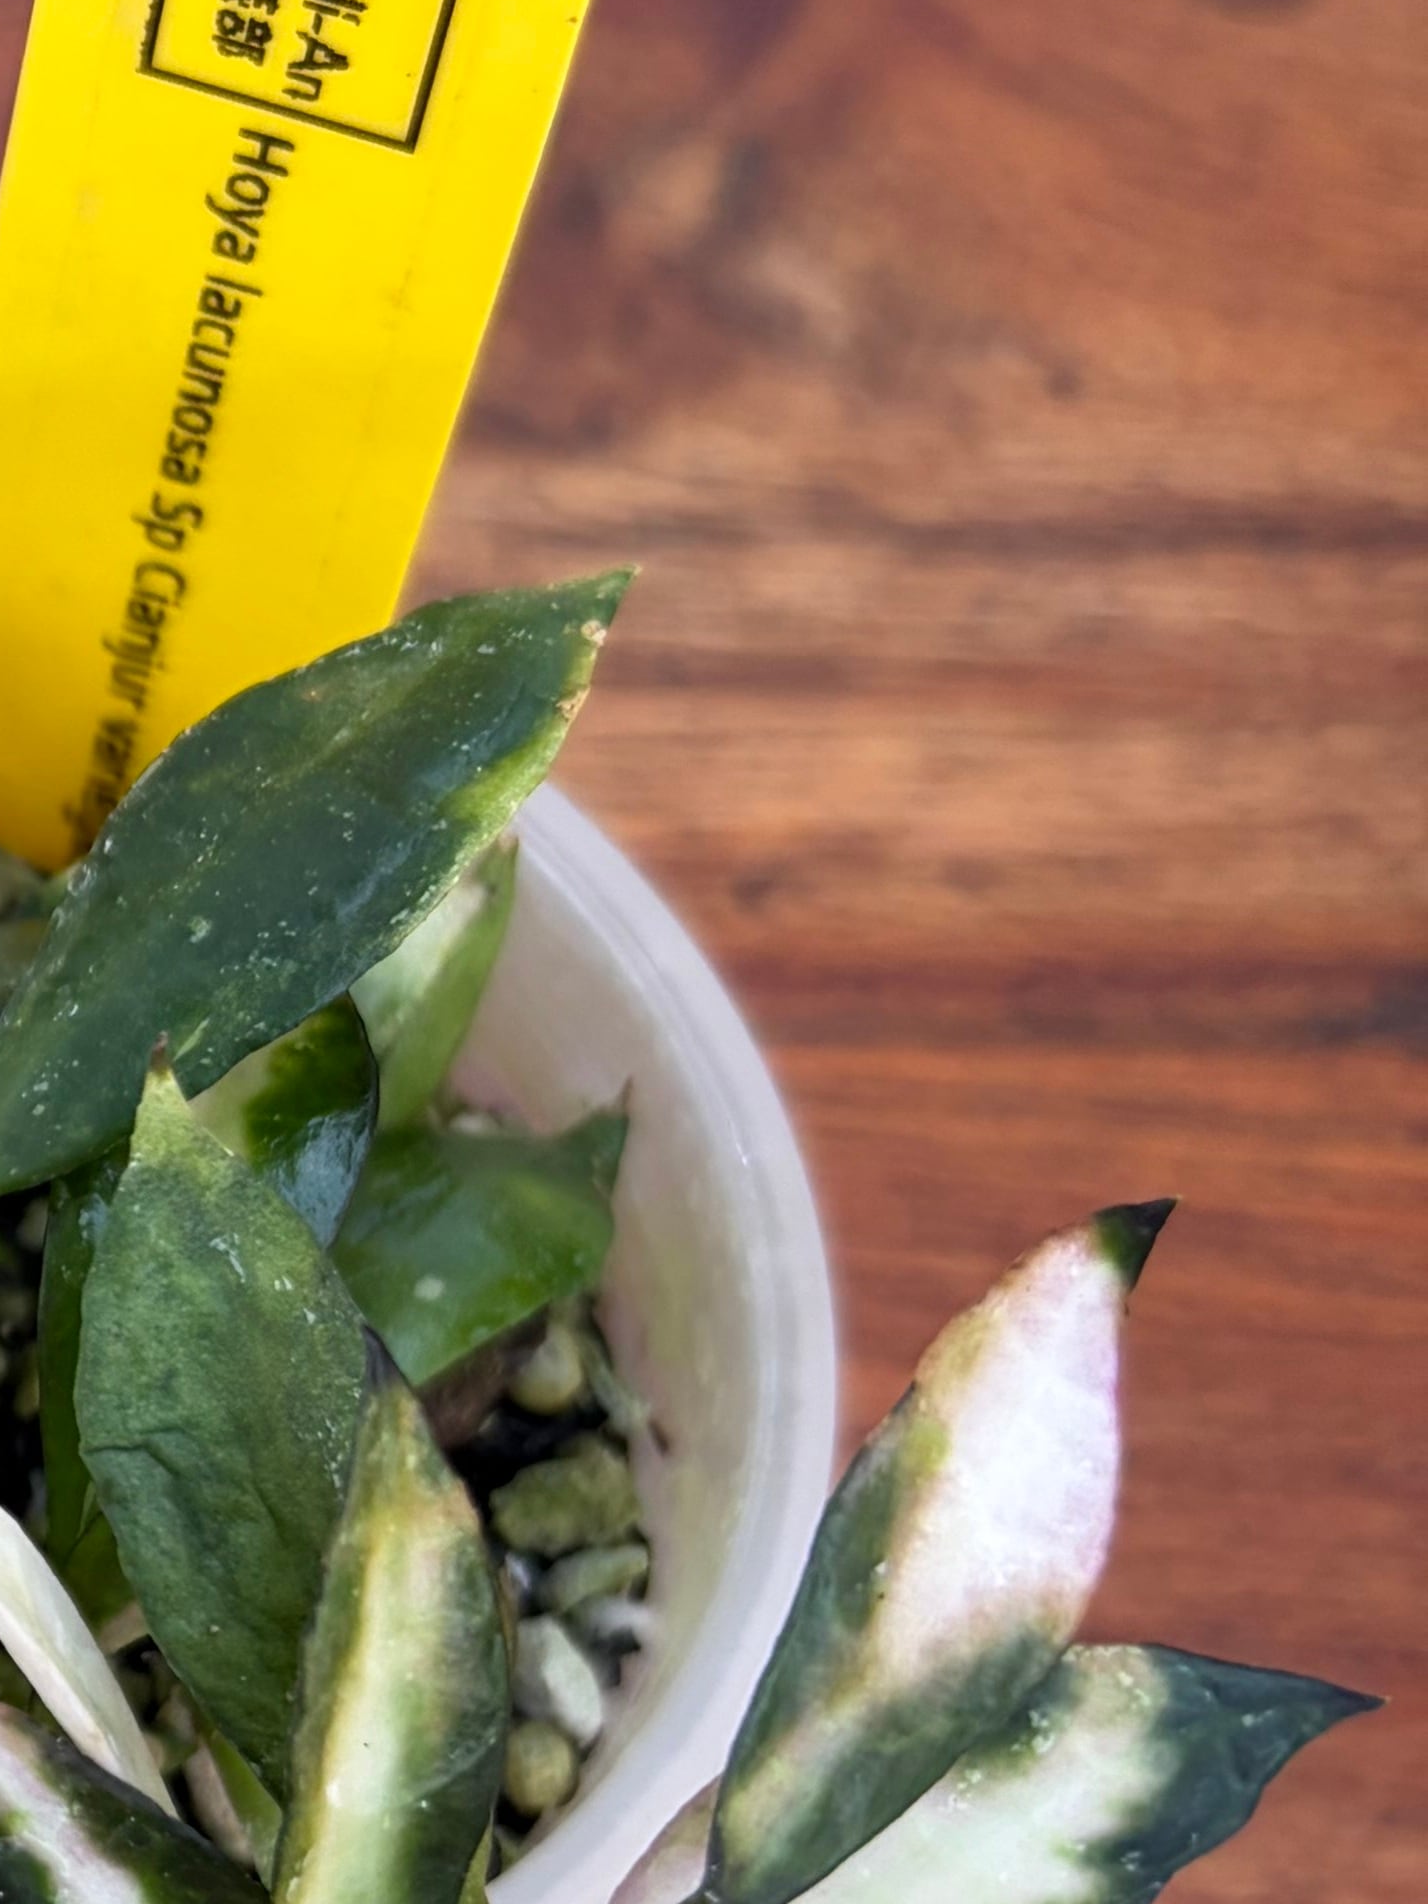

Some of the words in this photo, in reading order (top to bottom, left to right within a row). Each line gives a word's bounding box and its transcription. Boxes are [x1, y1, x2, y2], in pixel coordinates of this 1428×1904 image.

[204, 127, 294, 264] Hoya
[156, 274, 263, 486] lacunosa
[132, 493, 204, 551] Sp
[102, 562, 187, 710] Cianjur
